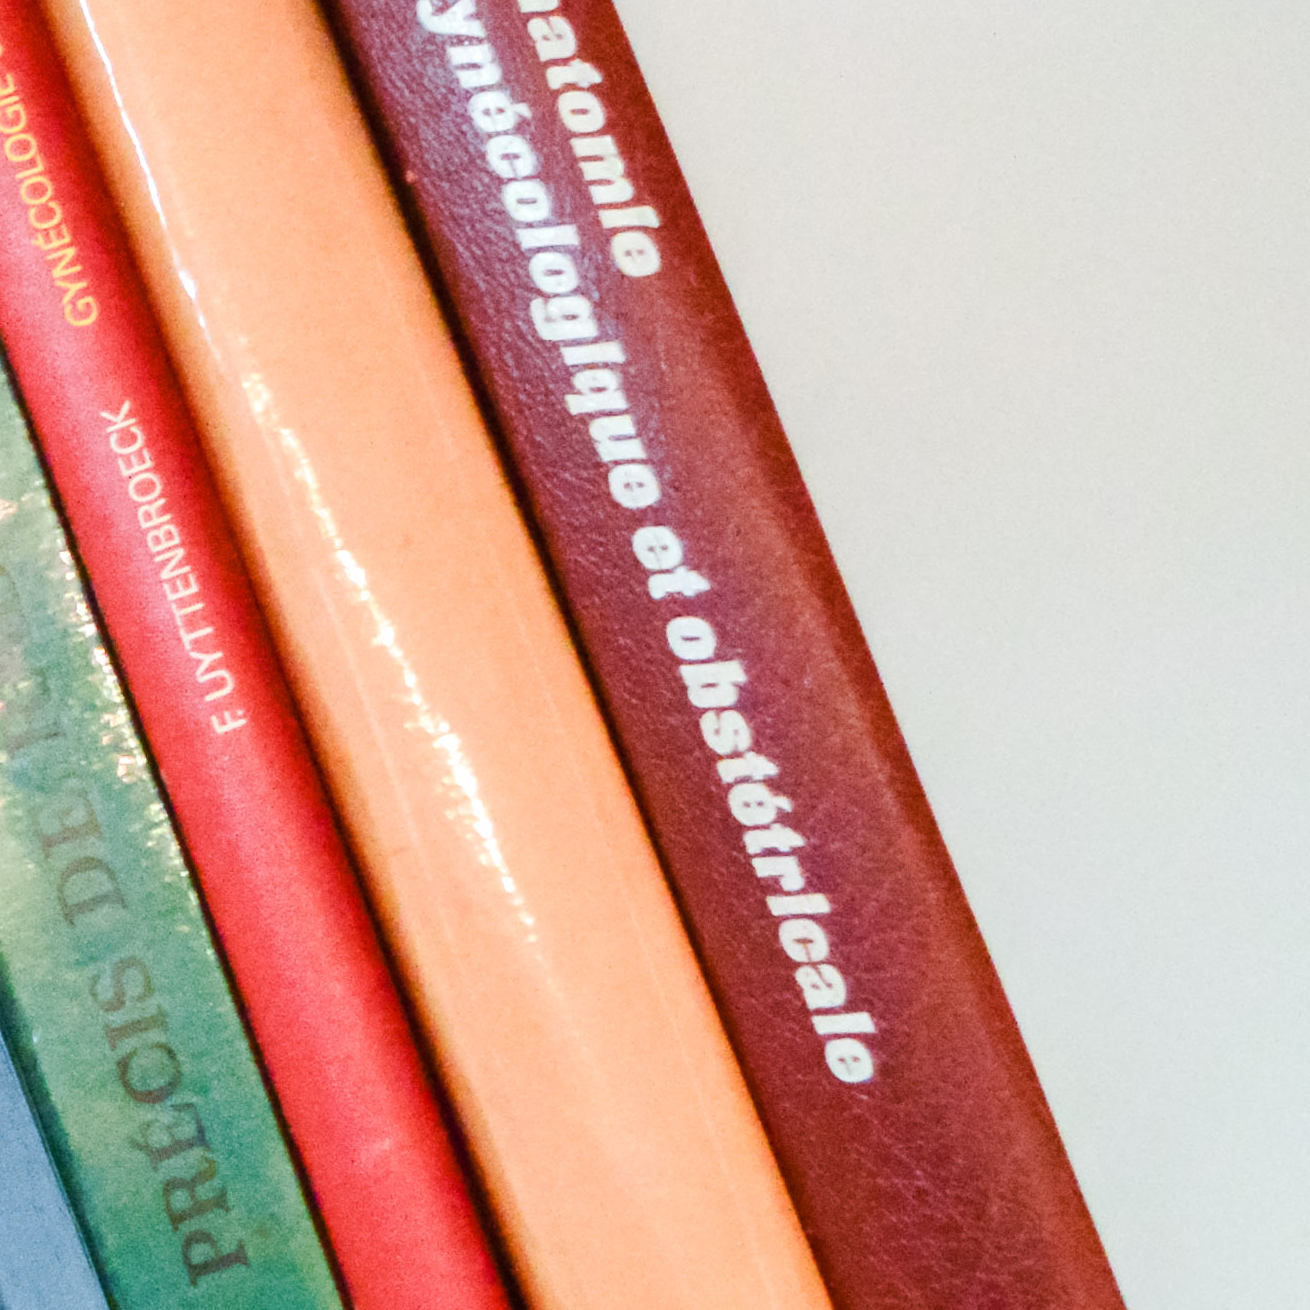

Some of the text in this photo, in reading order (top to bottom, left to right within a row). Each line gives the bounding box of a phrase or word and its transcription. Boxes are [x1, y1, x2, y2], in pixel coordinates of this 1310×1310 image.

[100, 400, 235, 702] UYTTENBROECK
[631, 525, 711, 599] et
[39, 794, 127, 926] DE
[665, 616, 877, 1084] obstétricale
[90, 956, 250, 1287] PRÉCIS
